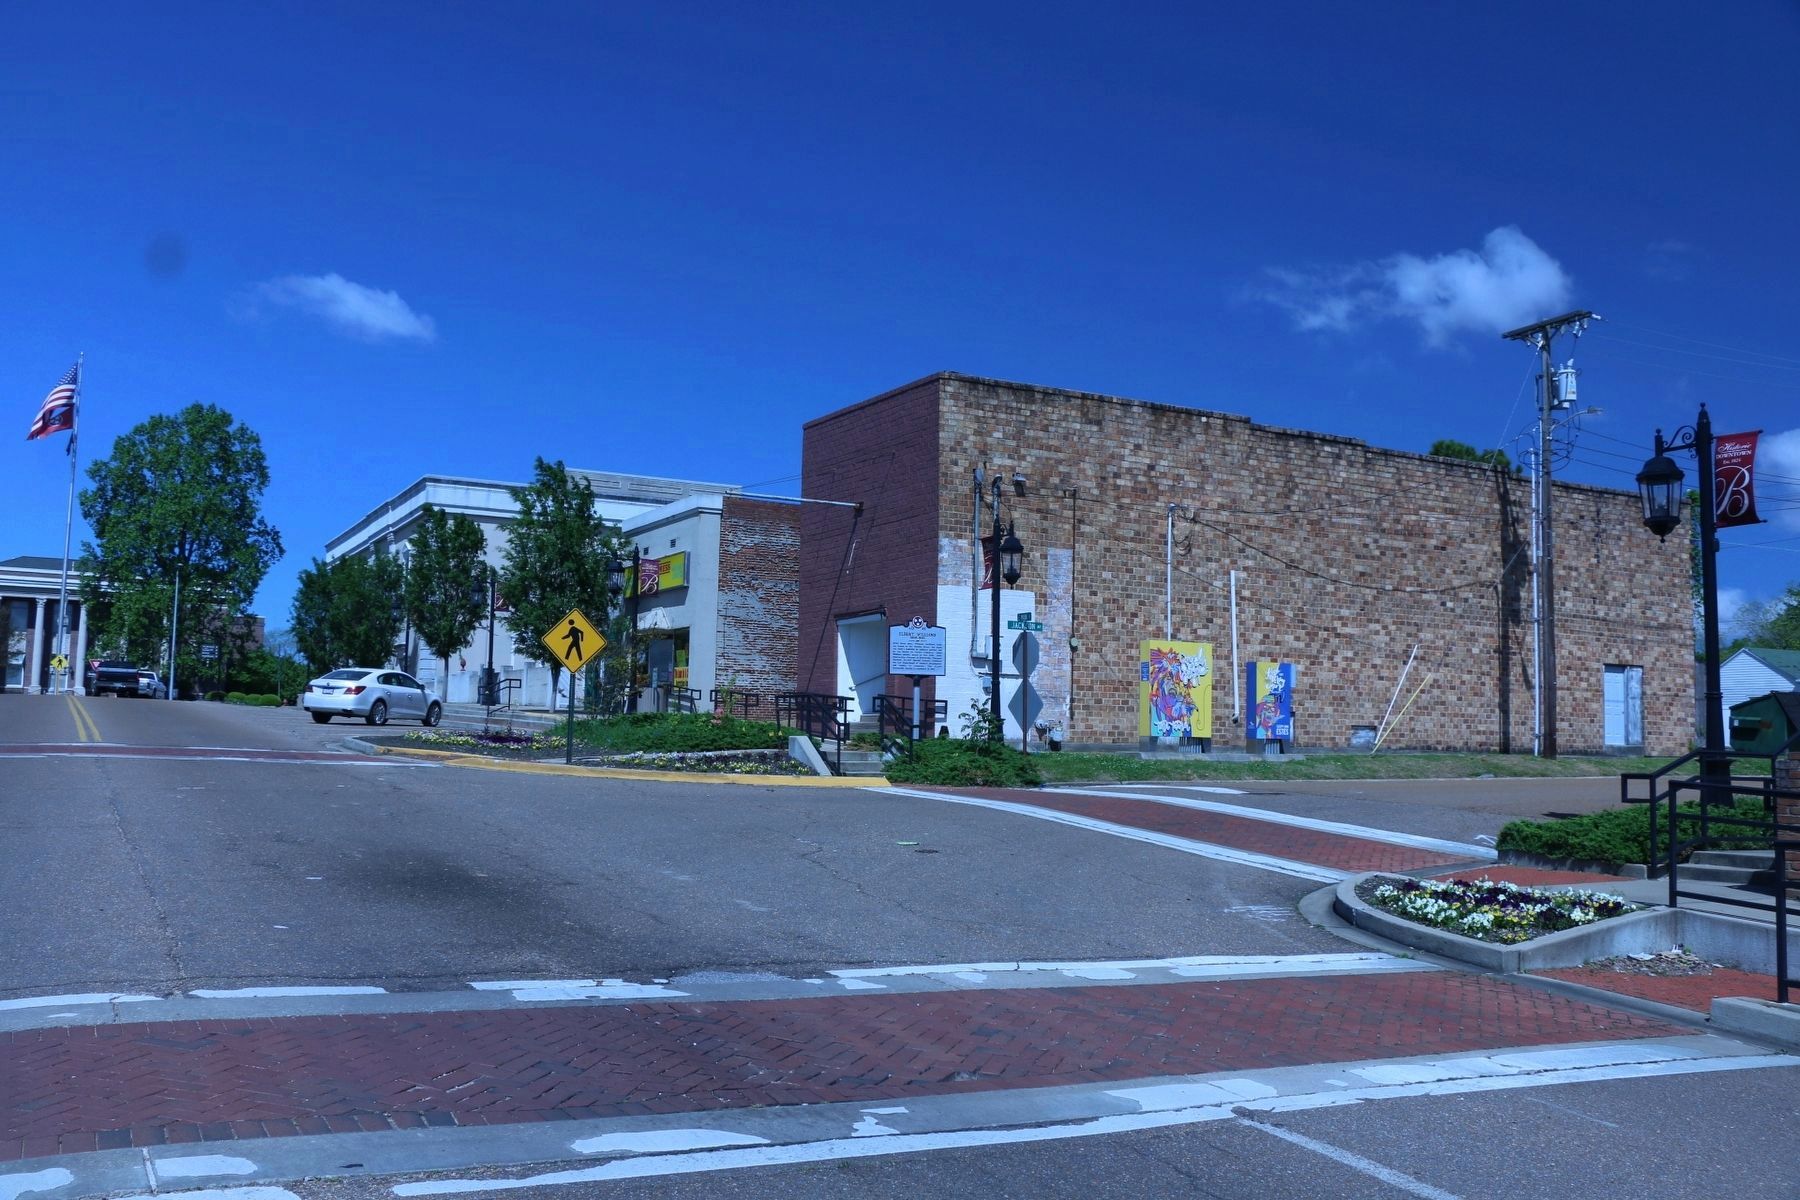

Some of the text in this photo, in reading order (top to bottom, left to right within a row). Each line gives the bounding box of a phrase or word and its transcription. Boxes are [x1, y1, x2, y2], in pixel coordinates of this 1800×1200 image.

[1716, 450, 1752, 459] DOWNTOWN
[1717, 442, 1752, 453] Historic
[1716, 465, 1752, 517] B
[640, 572, 659, 594] B
